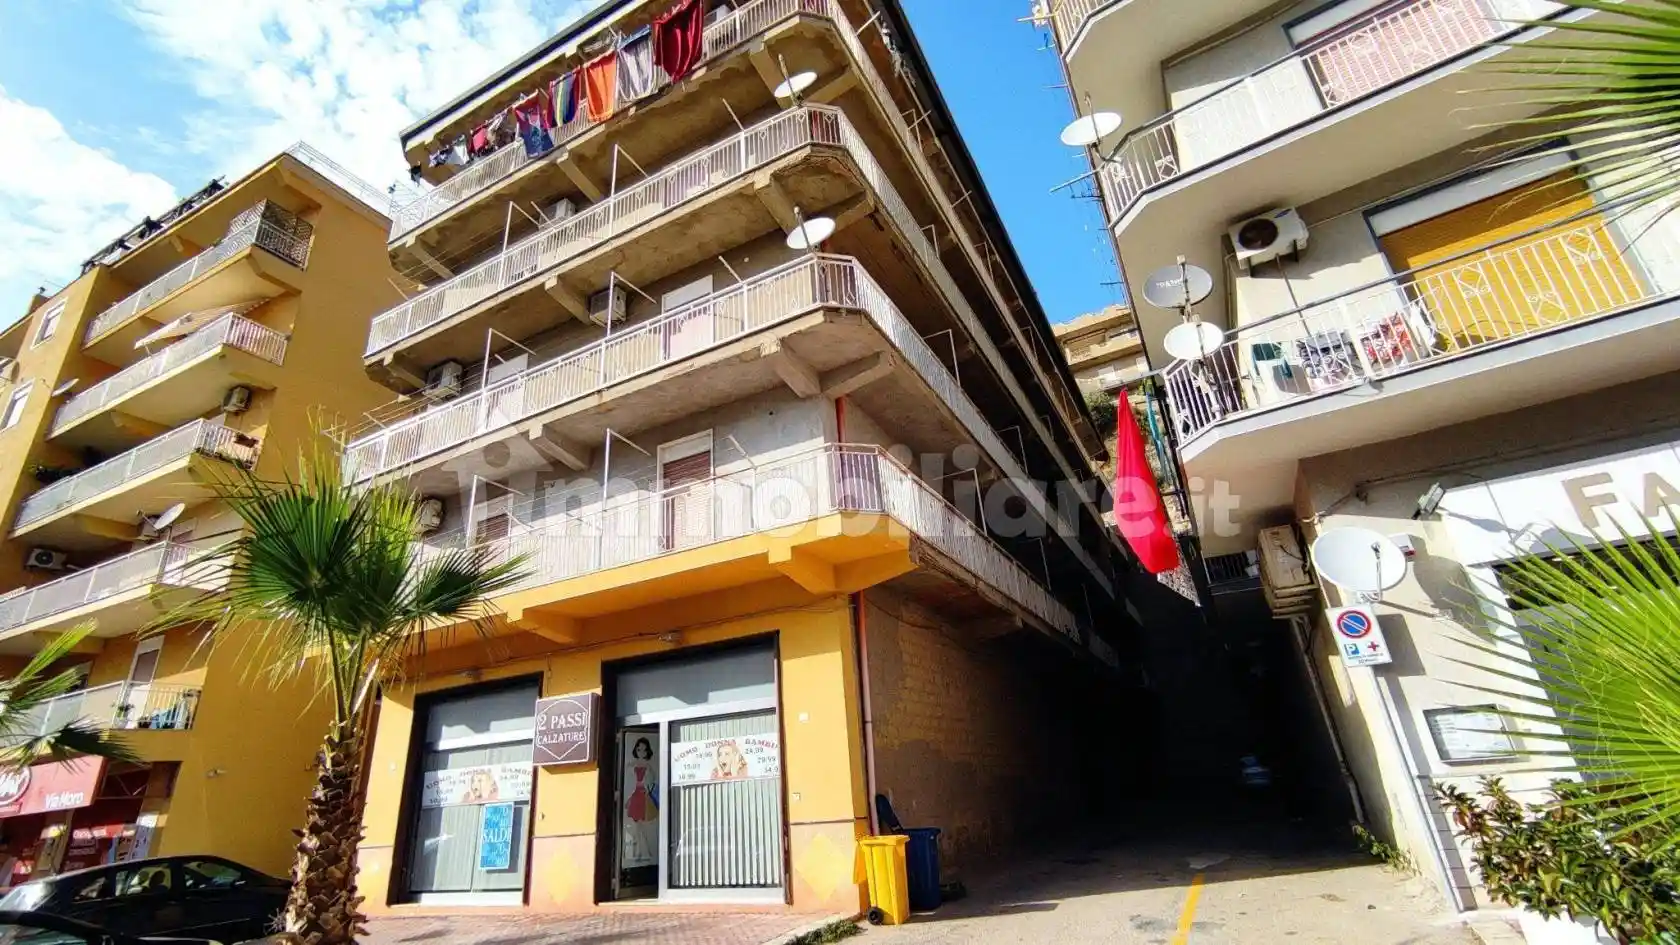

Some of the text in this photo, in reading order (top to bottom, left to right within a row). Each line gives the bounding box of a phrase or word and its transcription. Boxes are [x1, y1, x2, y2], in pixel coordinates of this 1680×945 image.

[538, 712, 586, 730] 2 PASSI
[538, 731, 585, 744] CALZATURE
